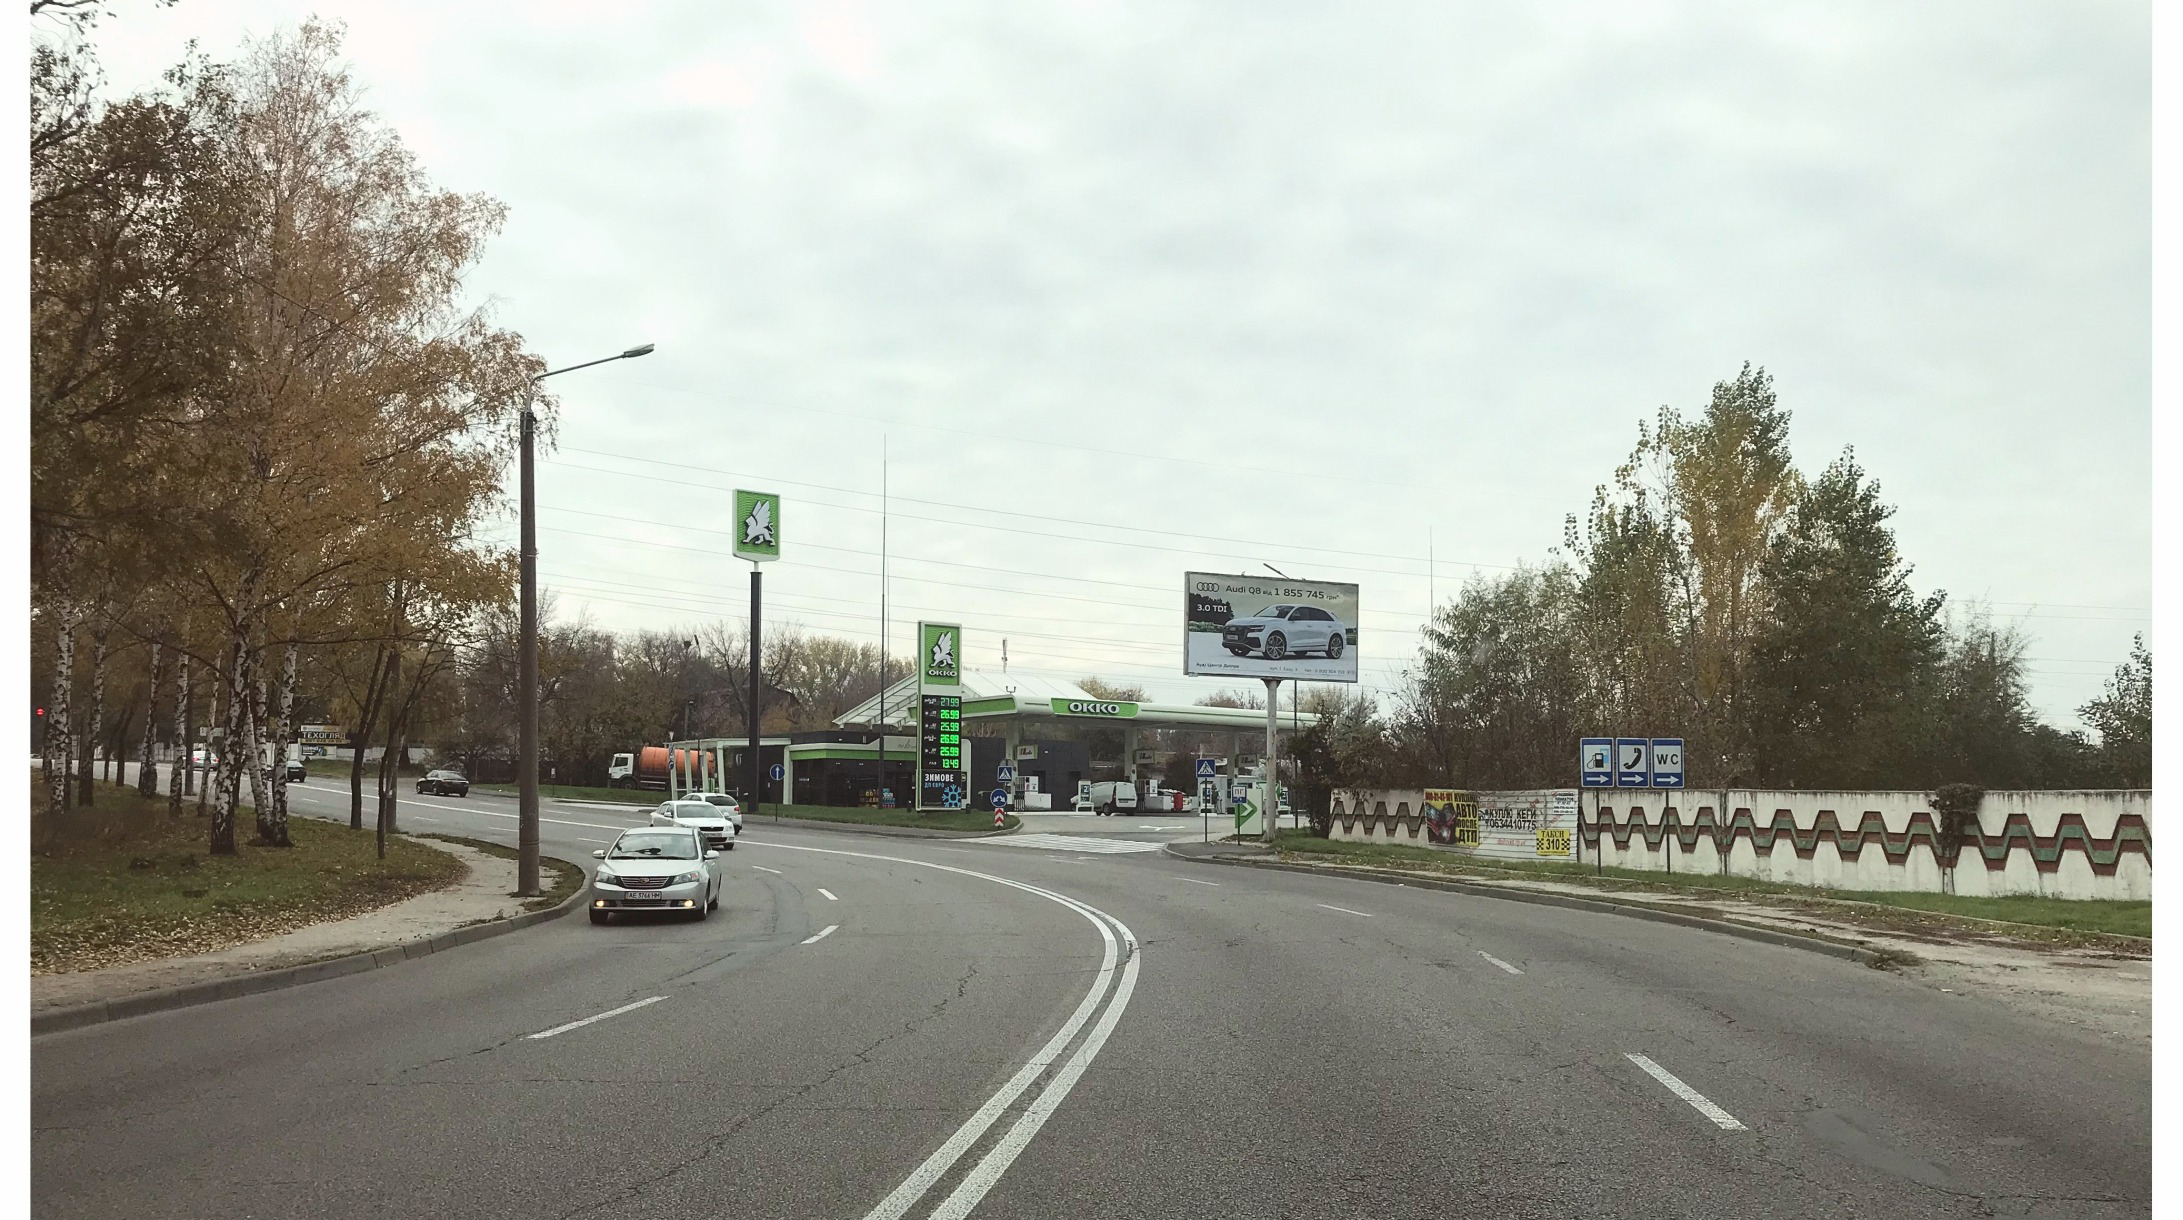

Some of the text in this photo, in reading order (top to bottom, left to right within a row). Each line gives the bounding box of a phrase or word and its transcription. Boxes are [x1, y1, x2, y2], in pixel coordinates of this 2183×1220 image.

[1226, 585, 1246, 593] Audi
[1248, 586, 1261, 595] Q8
[1274, 588, 1280, 596] 1
[1283, 588, 1303, 598] 855
[1306, 590, 1325, 599] 745
[1196, 604, 1228, 613] 3.0 TDI
[928, 669, 958, 677] OKKO
[1069, 702, 1120, 714] OKKO
[940, 709, 960, 719] 26.99
[302, 731, 346, 739] ТЕХОГЛЯД
[1656, 753, 1679, 765] WC
[924, 773, 955, 782] ЗИМОВЕ
[1456, 803, 1478, 818] АВТО
[1489, 808, 1537, 819] КУПЛЮ КЕГИ
[1457, 819, 1477, 828] ПОСЛЕ
[1457, 829, 1477, 844] ДТП
[1546, 838, 1560, 850] 310
